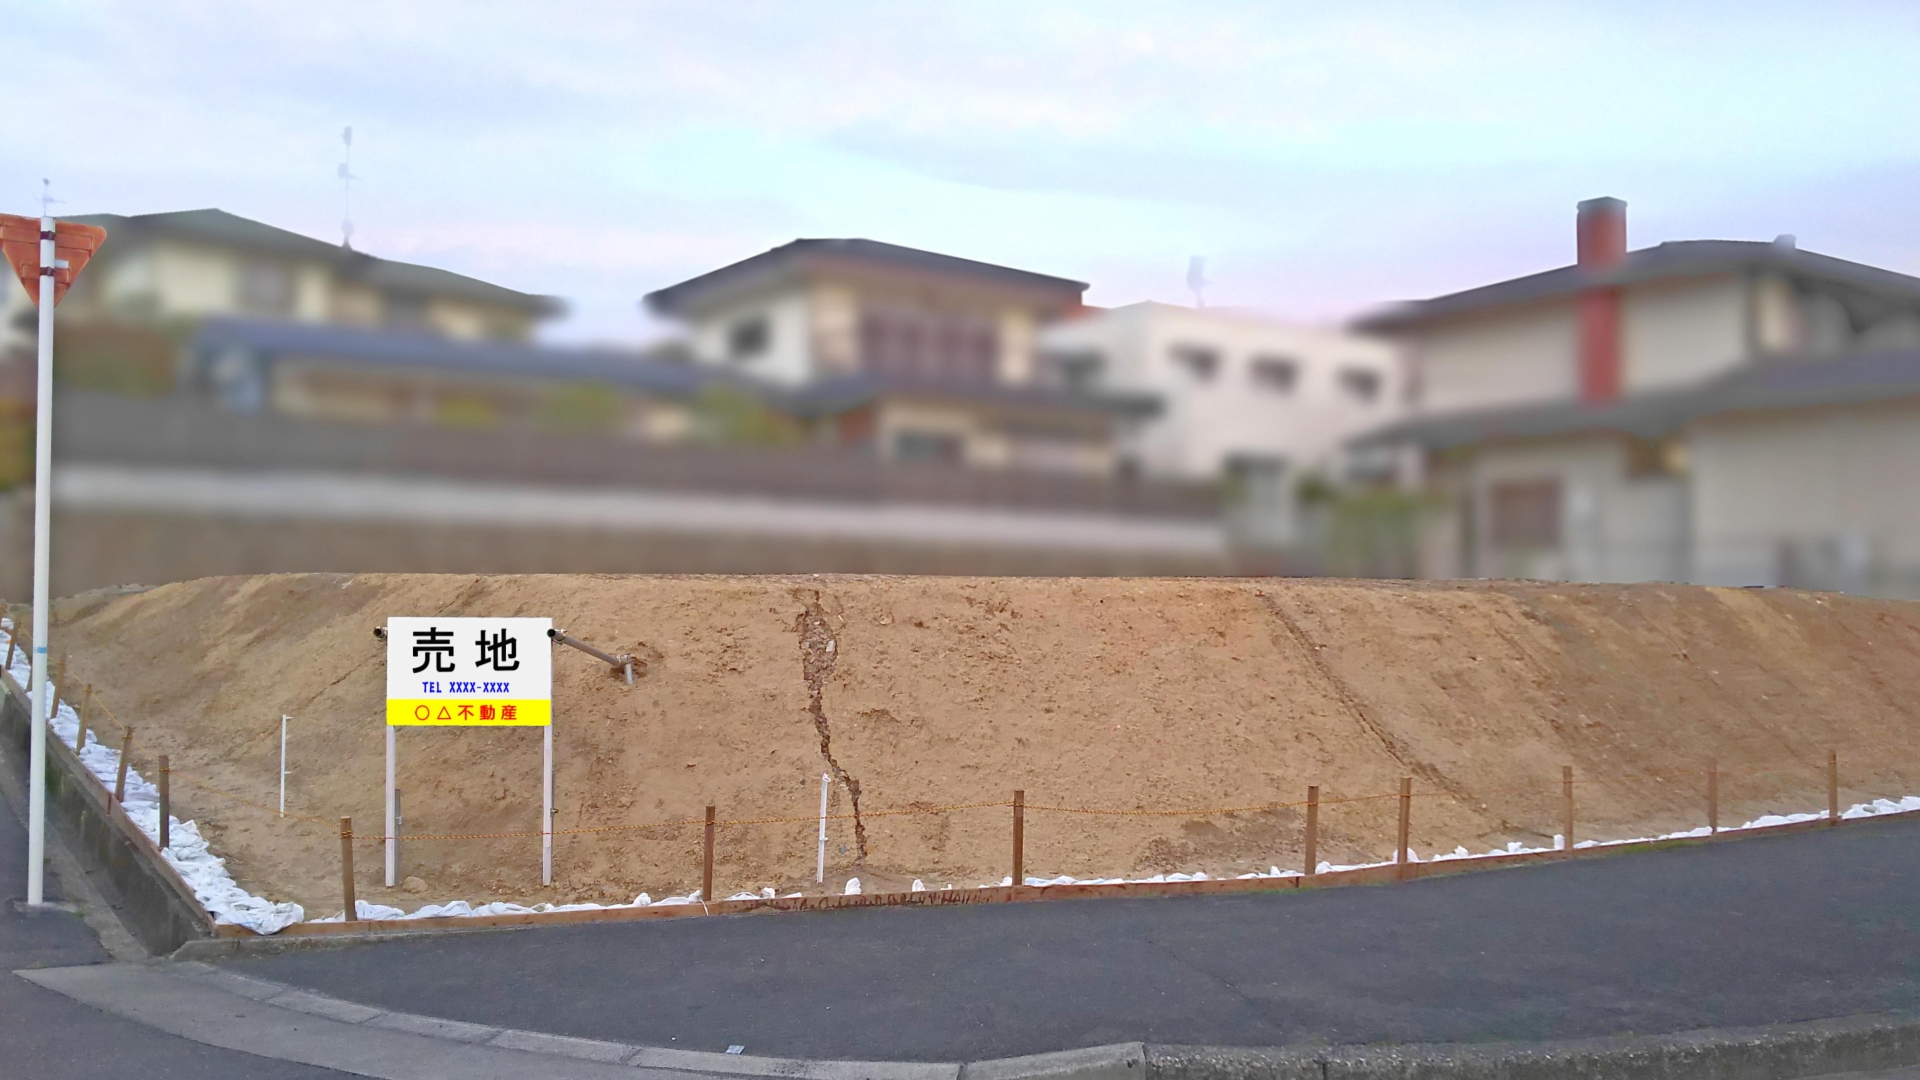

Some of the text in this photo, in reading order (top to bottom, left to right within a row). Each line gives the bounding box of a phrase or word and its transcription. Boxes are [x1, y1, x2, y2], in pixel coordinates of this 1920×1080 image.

[411, 626, 521, 674] 売地
[421, 681, 510, 694] TEL XXXX-XXXX
